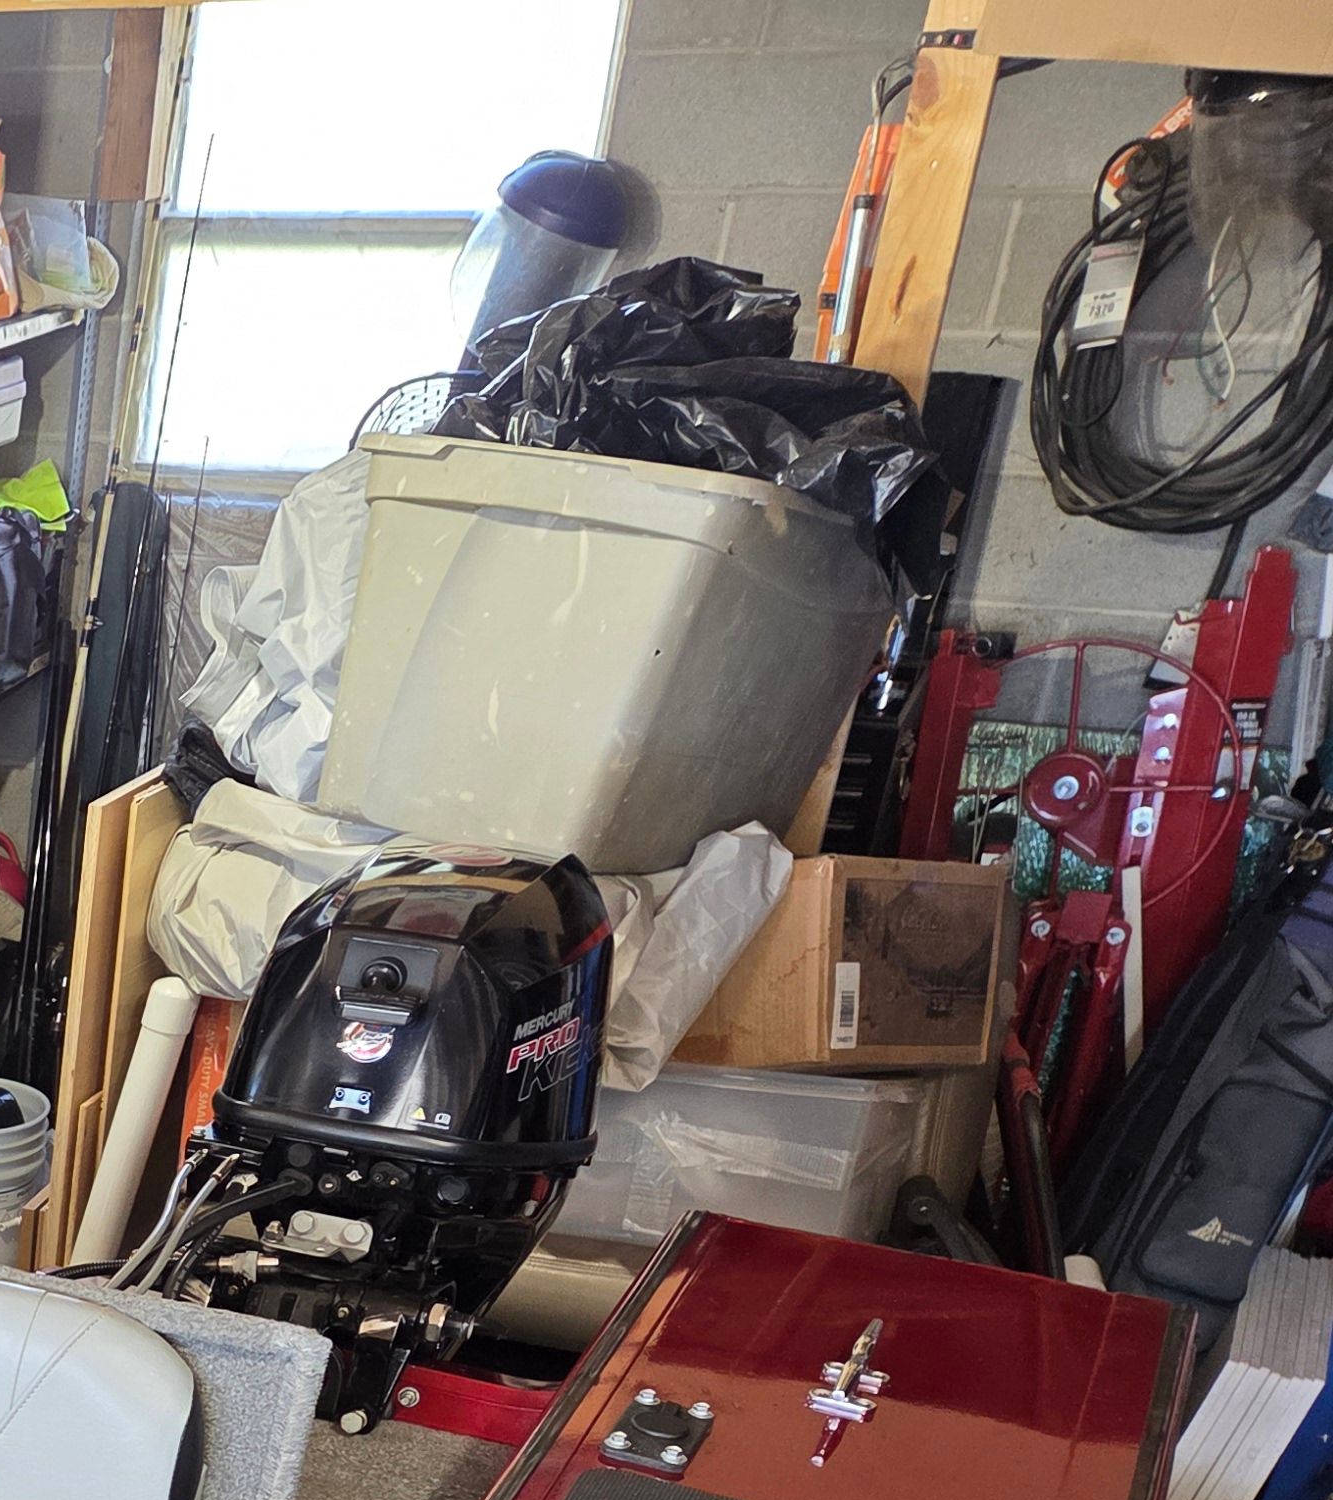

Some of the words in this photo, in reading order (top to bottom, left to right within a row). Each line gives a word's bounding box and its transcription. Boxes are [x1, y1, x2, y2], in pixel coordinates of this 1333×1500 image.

[513, 998, 576, 1041] MERCURY
[505, 1016, 581, 1074] PRO
[199, 1056, 214, 1091] DUTY
[195, 1090, 209, 1125] SMAL
